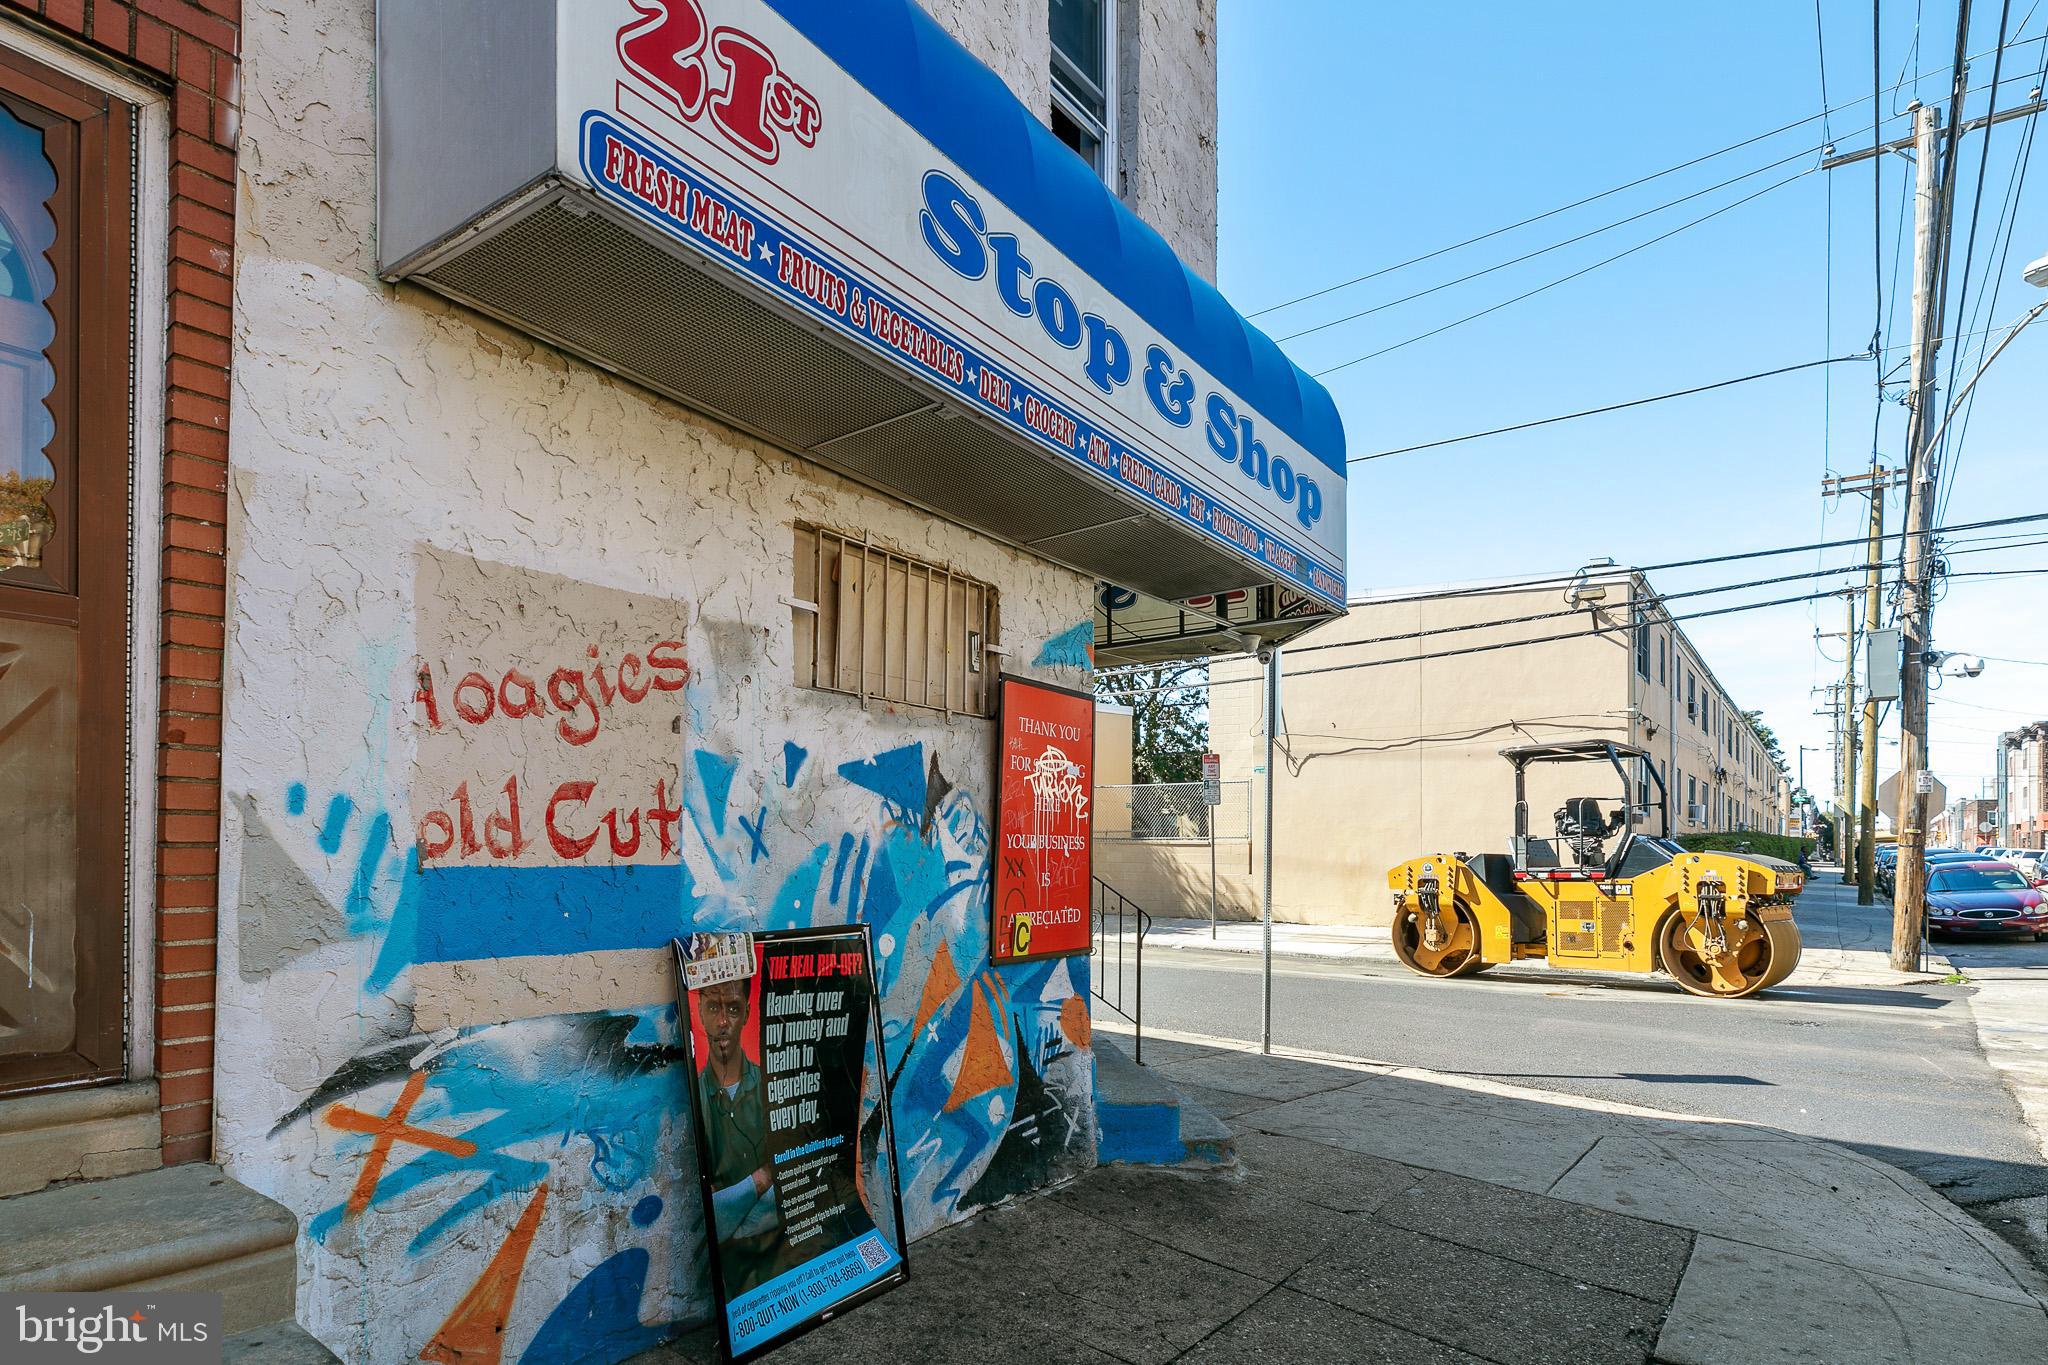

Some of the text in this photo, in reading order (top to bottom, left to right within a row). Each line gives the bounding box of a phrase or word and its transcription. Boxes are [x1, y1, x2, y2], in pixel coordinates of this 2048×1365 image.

[616, 0, 1322, 530] 21ST Stop & Shop
[604, 136, 688, 220] FRESH
[691, 190, 755, 259] MEAT
[778, 242, 847, 316] FRUITS
[850, 287, 866, 328] &
[868, 297, 964, 385] VEGETABLES
[979, 365, 1012, 413] DELI
[1025, 394, 1077, 450] GROCERY
[1088, 432, 1110, 469] ATM
[1120, 451, 1154, 494] CREDIT
[1154, 472, 1181, 510] CARDS
[1190, 492, 1205, 523] EBT
[1213, 506, 1240, 544] FROZEN
[1240, 522, 1258, 553] FOOD
[1265, 537, 1275, 563] WE
[1275, 544, 1297, 575] ACCEPT
[1019, 716, 1080, 741] THANK YOU
[1010, 755, 1031, 772] FOR
[1039, 834, 1085, 850] BUSINESS
[1041, 873, 1051, 887] IS
[1615, 885, 1631, 894] CAT
[1016, 922, 1030, 952] C
[769, 956, 789, 979] THE
[790, 955, 814, 979] REAL
[817, 953, 863, 977] RIP-OFF?
[766, 990, 844, 1017] Handing over
[766, 1013, 850, 1047] my money and
[766, 1045, 814, 1074] health to
[767, 1072, 820, 1104] cigarettes
[769, 1099, 819, 1132] every day.
[774, 1149, 790, 1165] Enroll
[790, 1148, 796, 1158] in
[796, 1146, 805, 1157] the
[825, 1137, 832, 1147] to
[799, 1259, 866, 1306] (1-800-784-8669)
